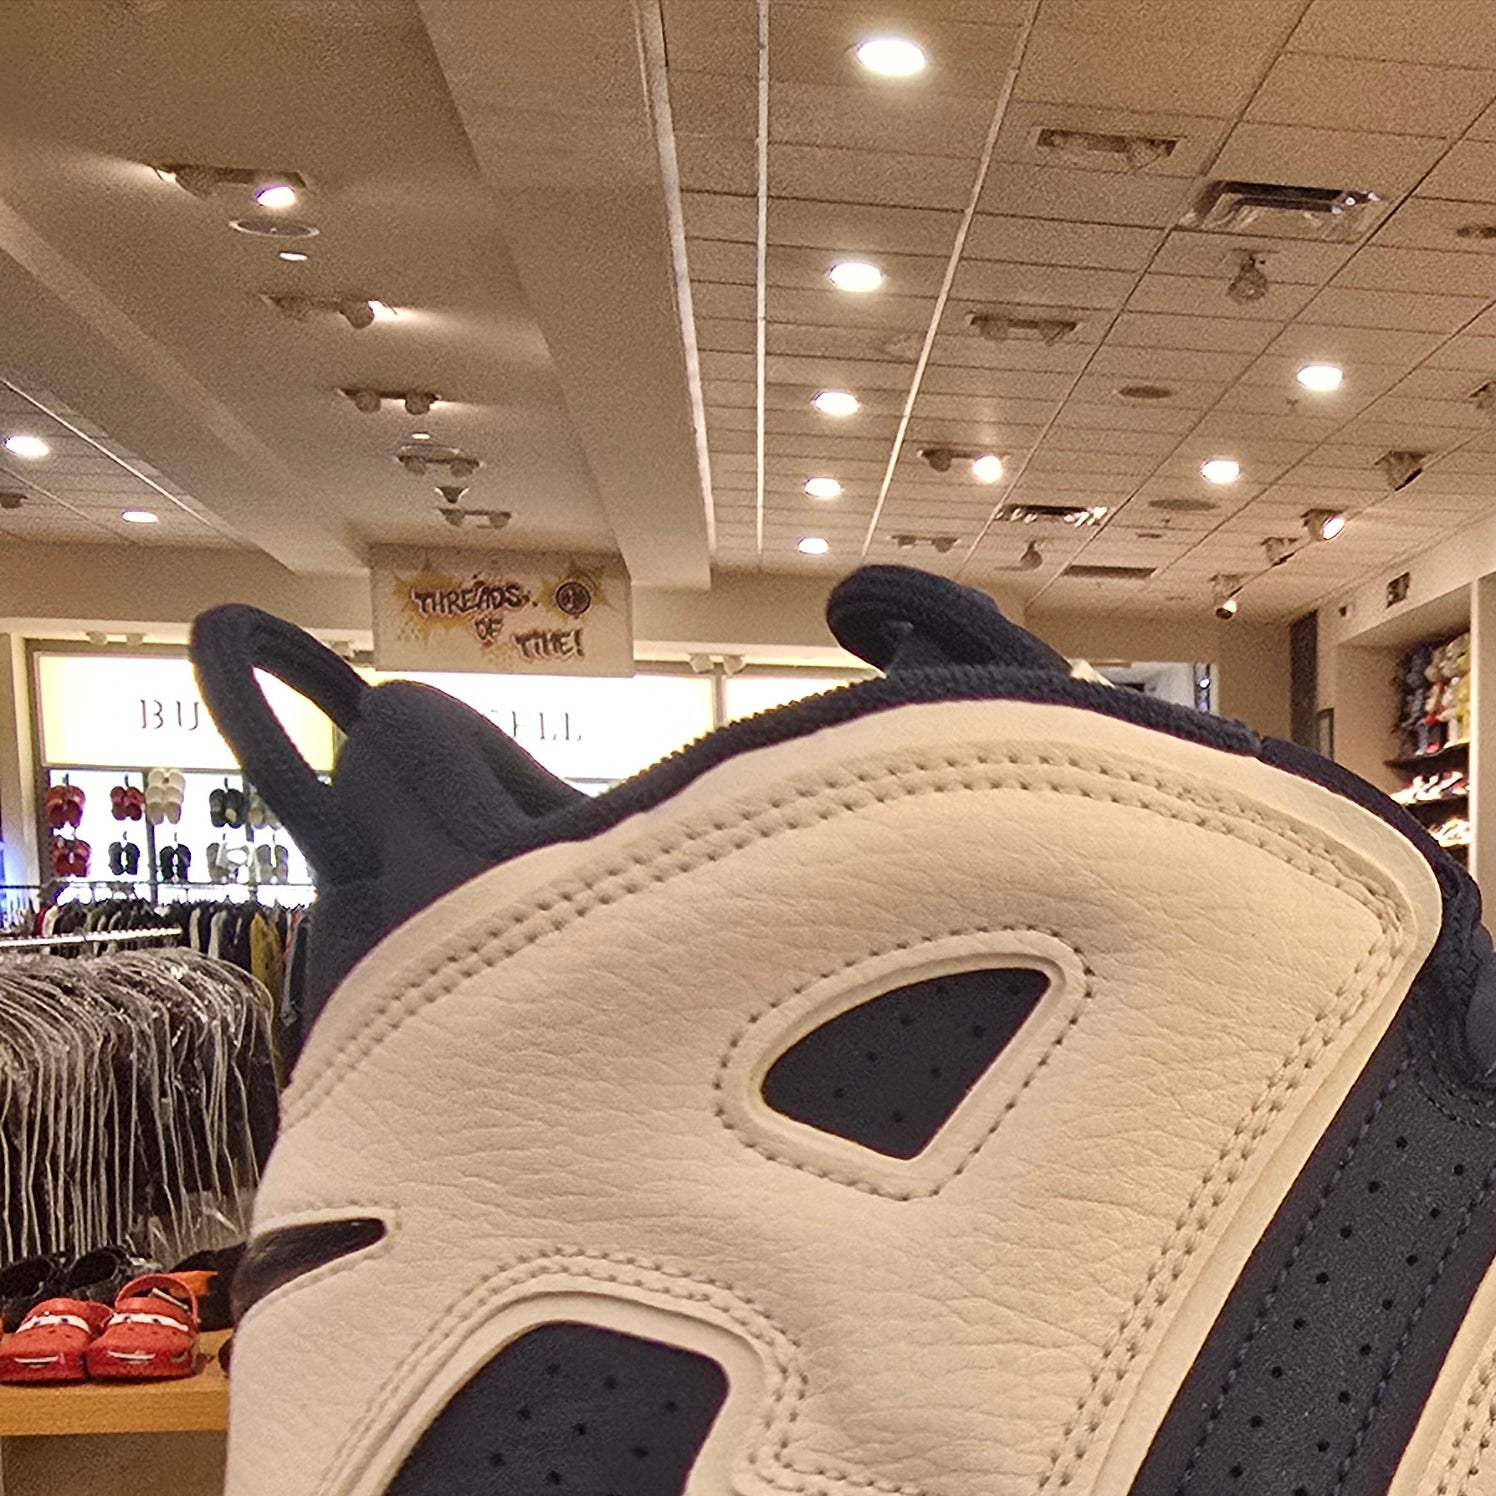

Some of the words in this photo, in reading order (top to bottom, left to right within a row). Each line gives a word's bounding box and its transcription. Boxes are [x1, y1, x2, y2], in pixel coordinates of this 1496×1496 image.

[412, 584, 525, 615] THREADS
[474, 614, 504, 641] OF
[139, 698, 200, 731] BU
[490, 708, 582, 742] ELL
